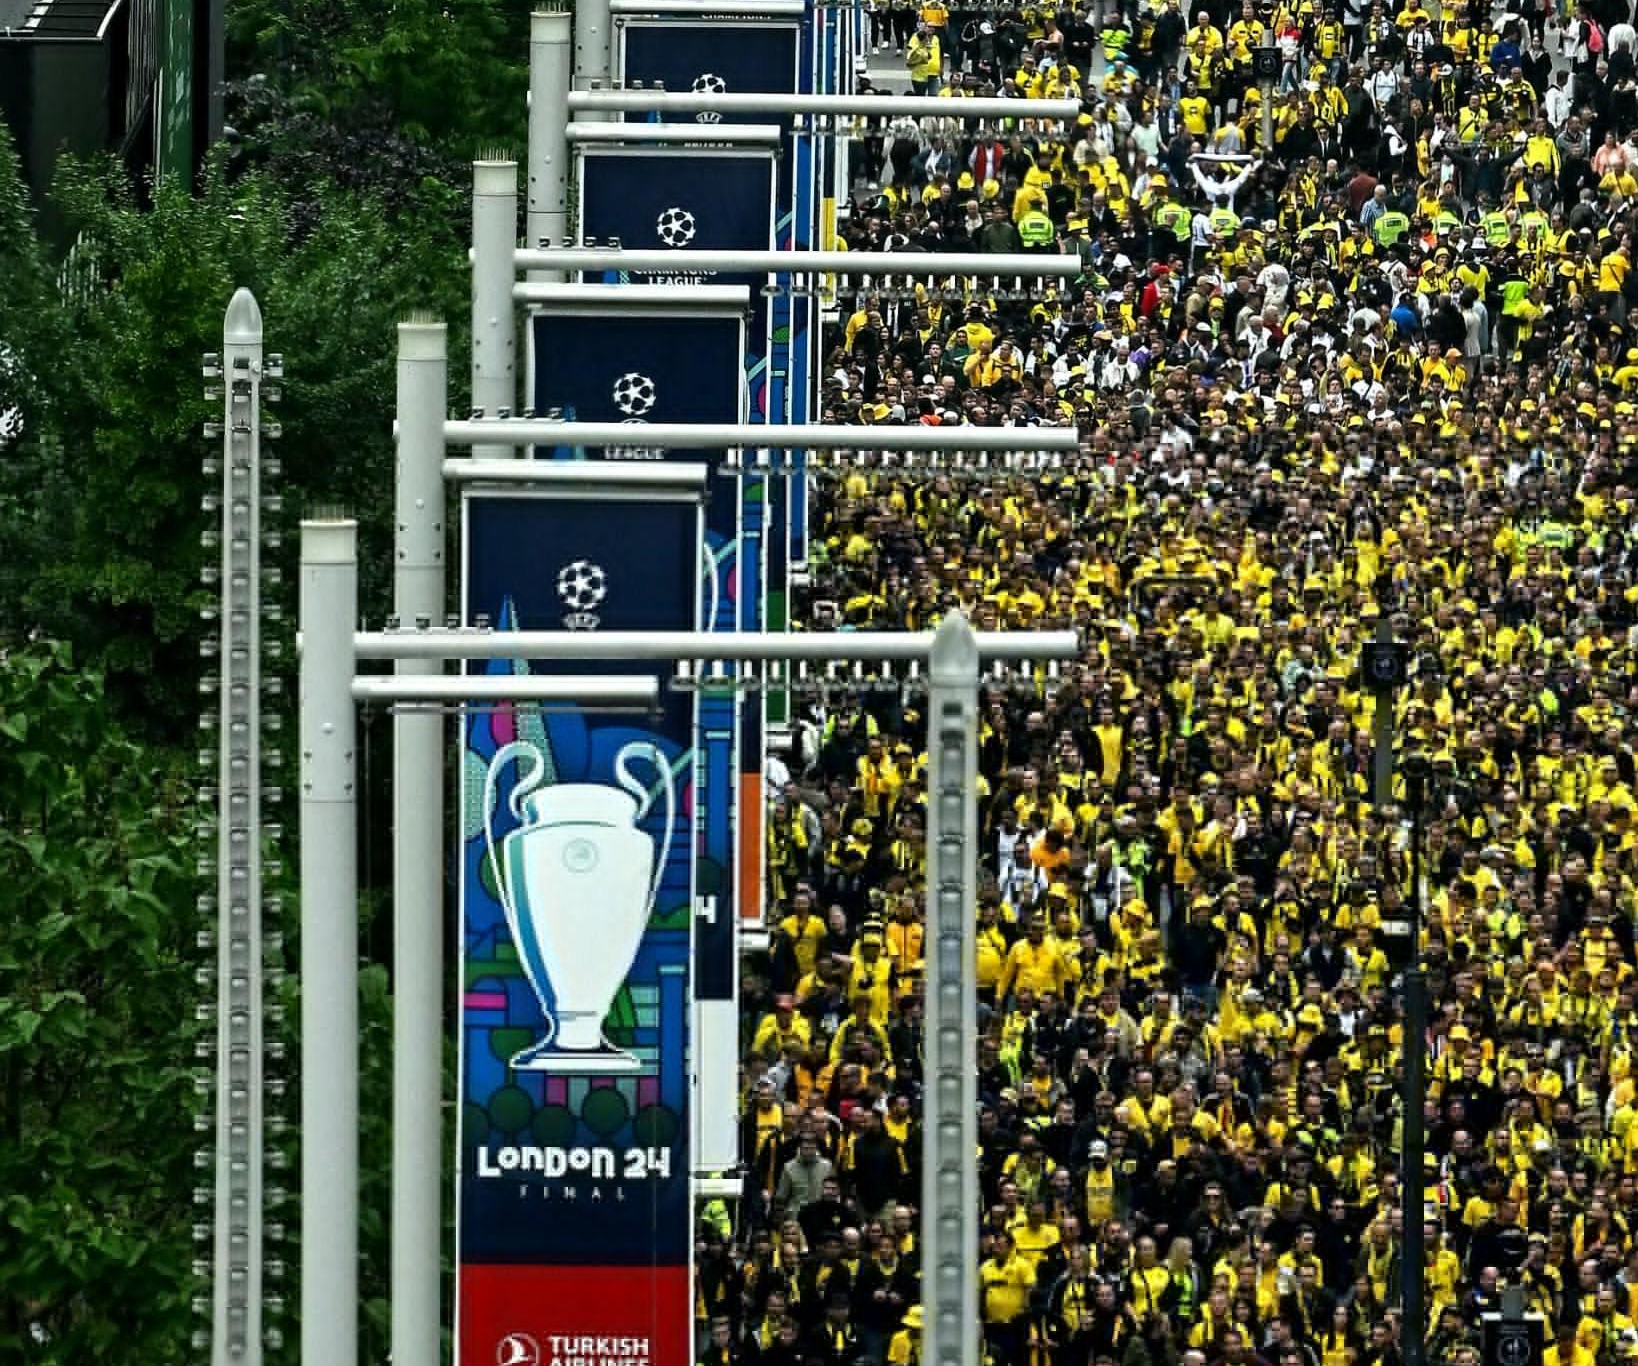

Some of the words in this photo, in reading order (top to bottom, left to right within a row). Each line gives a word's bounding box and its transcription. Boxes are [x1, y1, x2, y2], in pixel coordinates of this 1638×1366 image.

[623, 1146, 671, 1178] 24
[518, 1185, 626, 1201] FINAL
[550, 1337, 649, 1356] TURKISH
